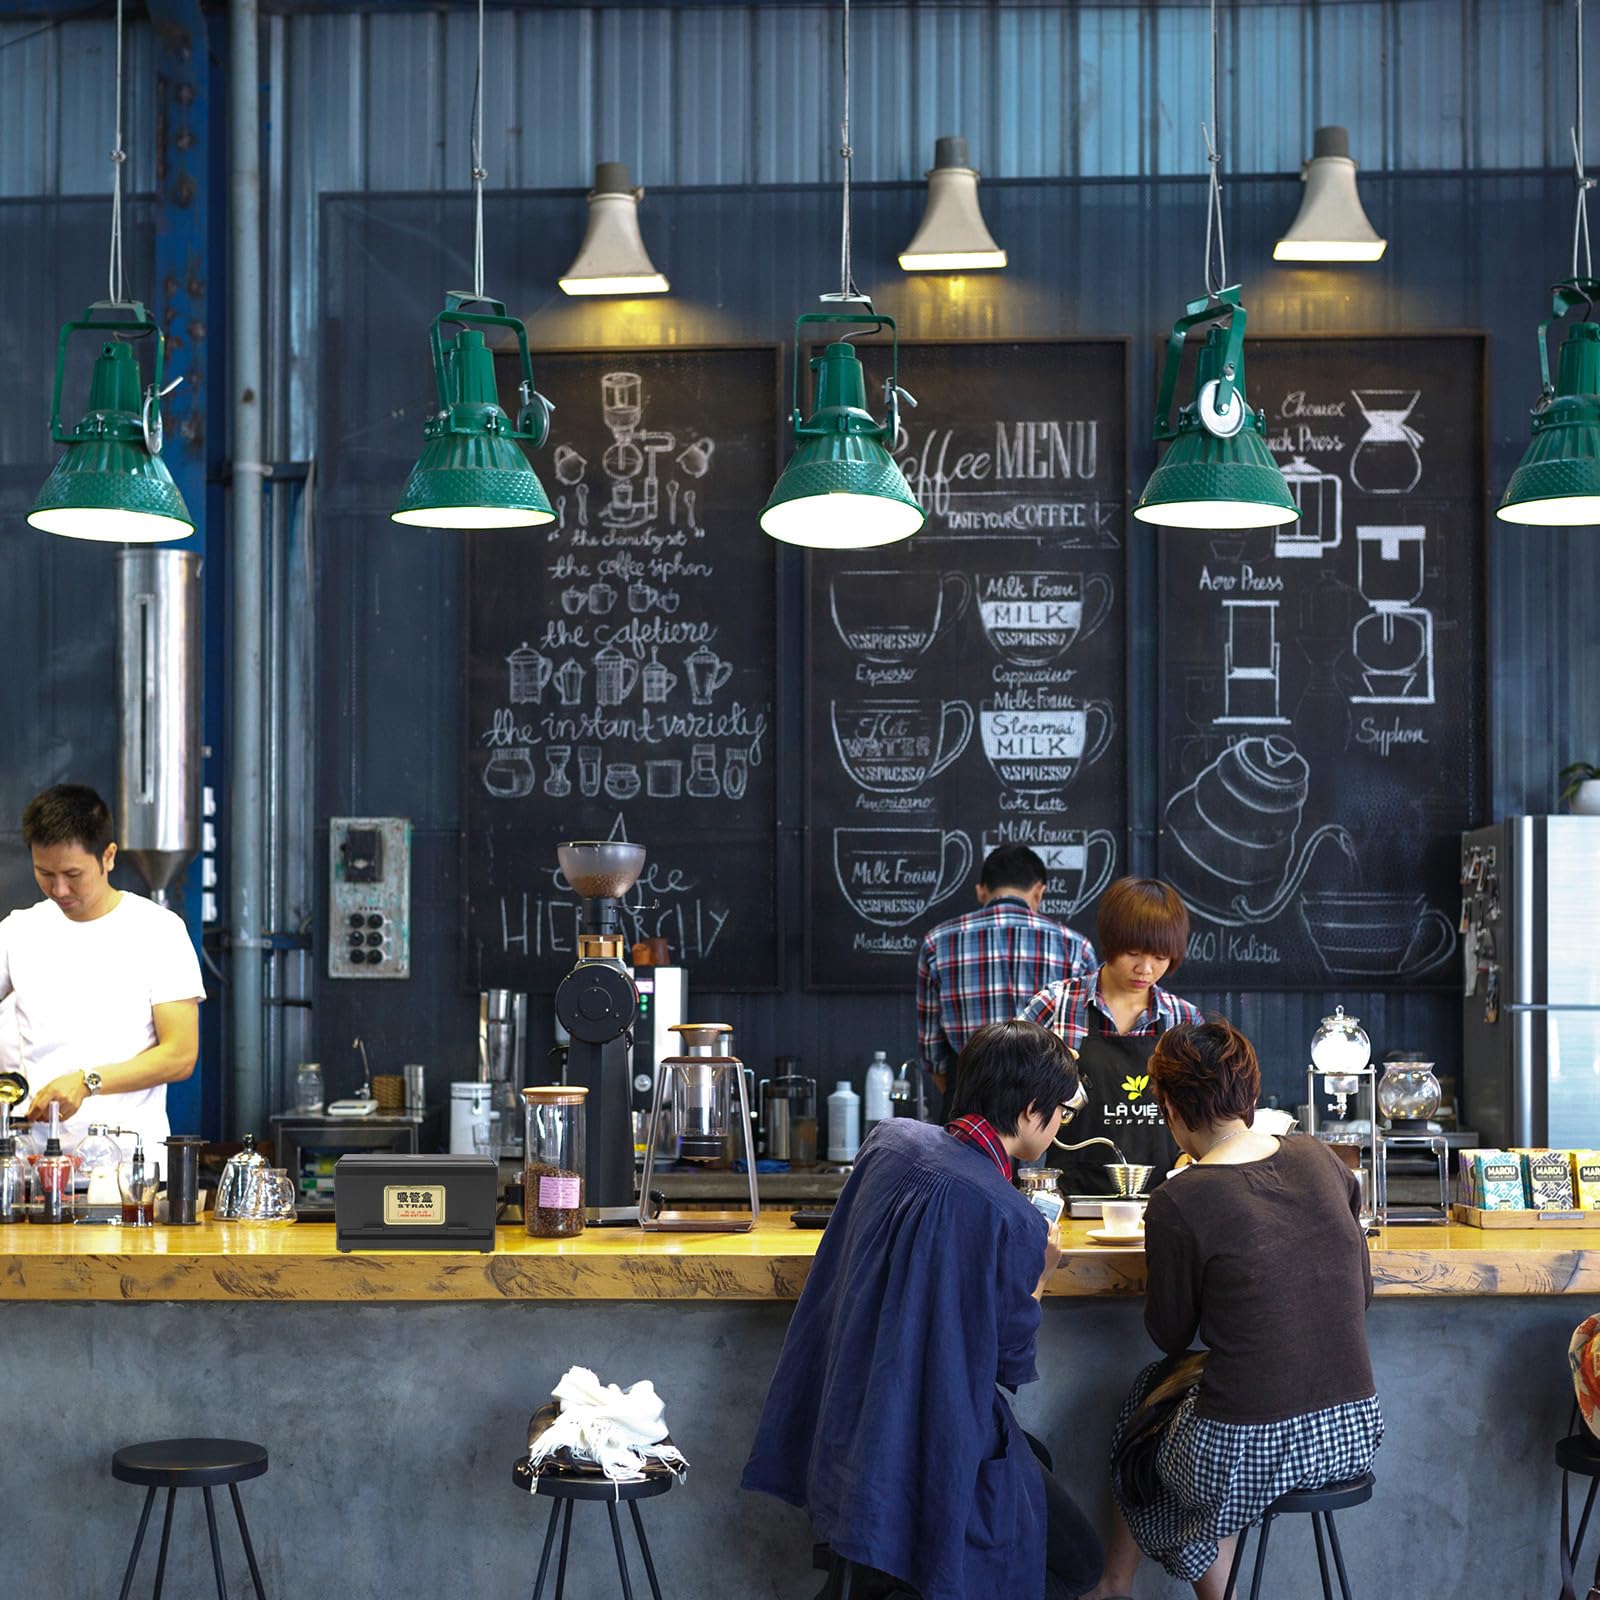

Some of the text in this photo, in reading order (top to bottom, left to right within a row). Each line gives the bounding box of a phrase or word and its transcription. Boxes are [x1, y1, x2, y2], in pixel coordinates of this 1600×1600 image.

[1281, 391, 1345, 418] Chemex
[1298, 423, 1345, 452] Press
[892, 420, 1098, 517] offee MENU
[949, 503, 1086, 529] TASTE YOUR COFFEE
[571, 528, 600, 547] the
[548, 551, 712, 582] the coffee siphon
[986, 576, 1027, 598] Milk
[1200, 565, 1284, 591] Aero Press
[994, 605, 1067, 624] MILK
[540, 617, 717, 660] the cafetiere
[849, 632, 927, 650] ESPRESSO
[996, 631, 1067, 647] ESPRESSO
[855, 663, 918, 687] Espresso
[994, 689, 1035, 710] Milk
[482, 701, 767, 766] the instant variety
[1355, 716, 1429, 756] Syphon
[842, 736, 931, 758] WATER
[996, 737, 1067, 756] MILK
[854, 766, 926, 782] ESPRESSO
[1000, 765, 1072, 782] ESPRESSO
[855, 793, 936, 809] Americano
[1033, 794, 1068, 812] Latte
[998, 819, 1035, 843] Milk
[851, 858, 937, 885] Milk Foam
[856, 898, 925, 914] ESPRESSO
[853, 931, 918, 950] Macchiato
[1228, 933, 1280, 964] Kalita
[1131, 1102, 1159, 1119] VIỆ
[1487, 1166, 1516, 1176] MAROU
[1535, 1166, 1564, 1176] MAROU
[1583, 1166, 1600, 1176] MAR
